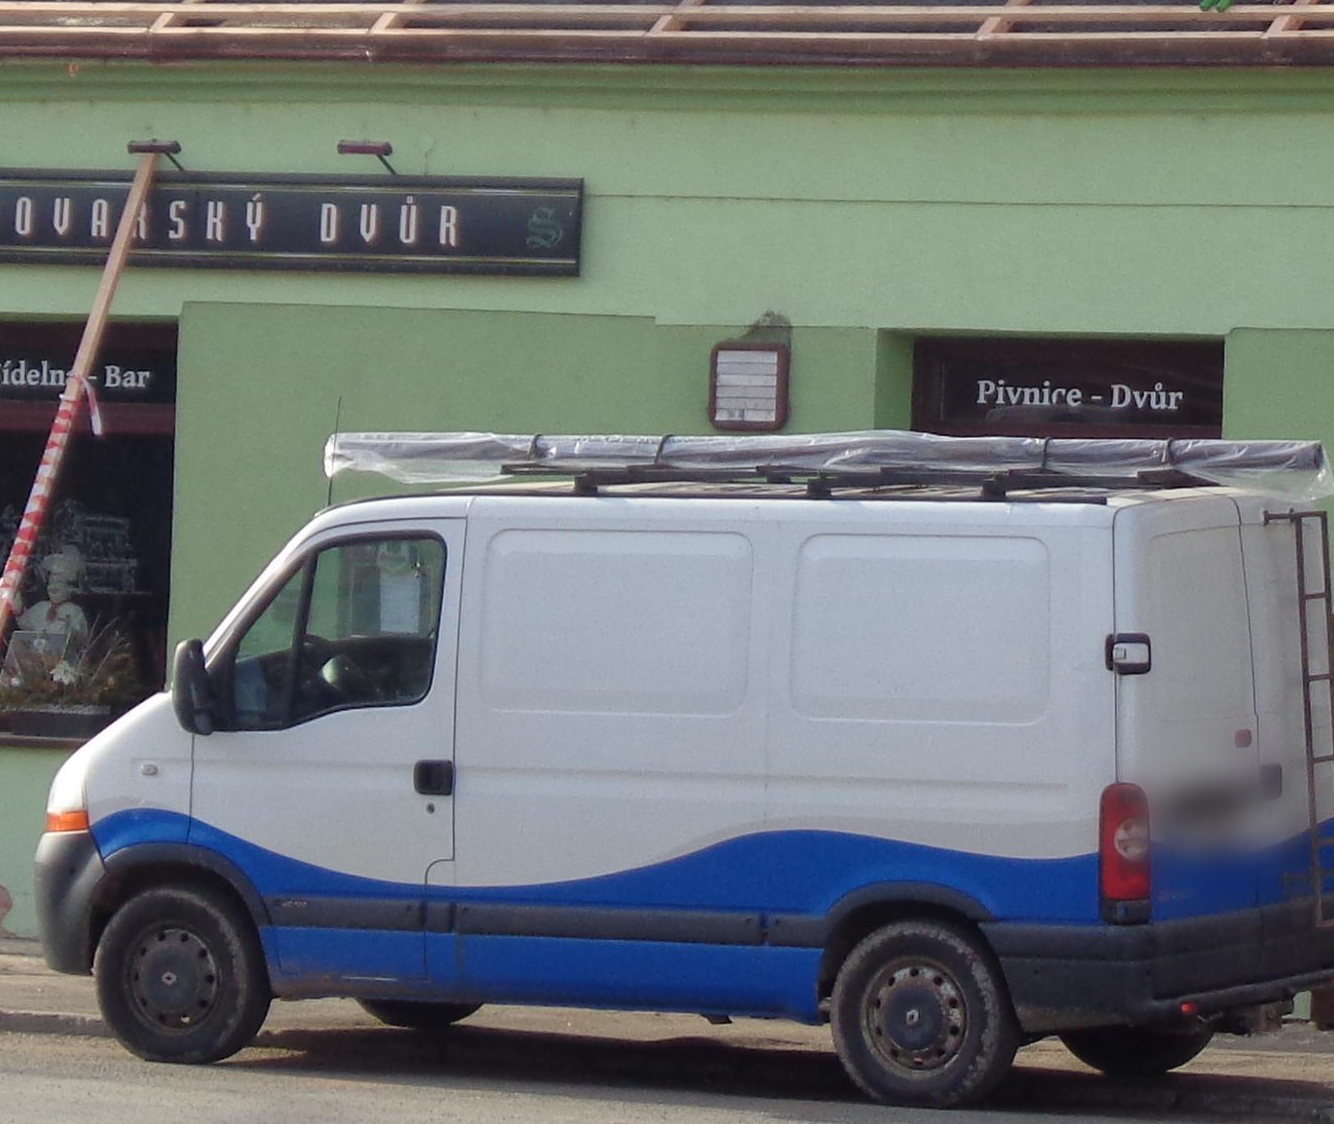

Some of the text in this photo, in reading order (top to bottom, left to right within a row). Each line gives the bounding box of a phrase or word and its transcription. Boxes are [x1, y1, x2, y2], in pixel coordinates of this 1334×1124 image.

[320, 195, 458, 247] DVŮR
[105, 365, 150, 387] Bar
[977, 379, 1082, 406] Pivnice
[1111, 382, 1183, 410] Dvůr
